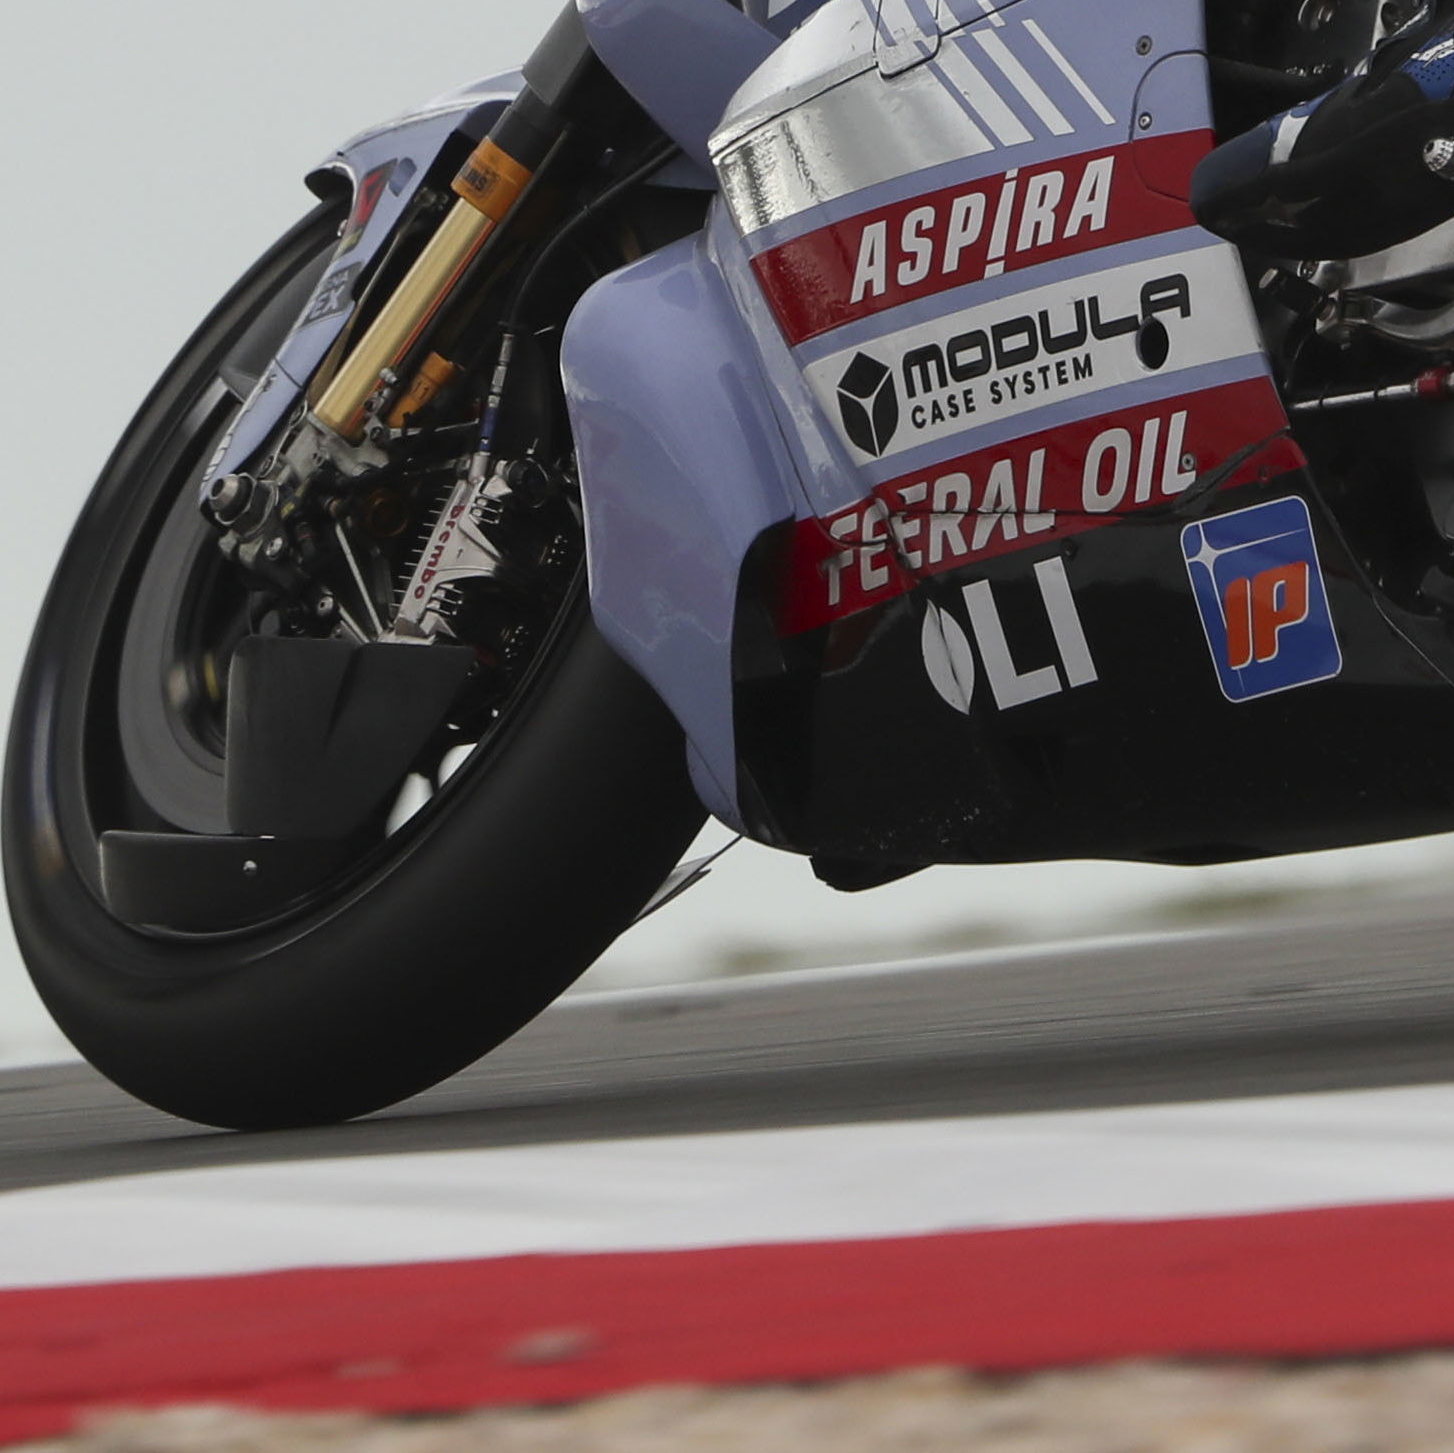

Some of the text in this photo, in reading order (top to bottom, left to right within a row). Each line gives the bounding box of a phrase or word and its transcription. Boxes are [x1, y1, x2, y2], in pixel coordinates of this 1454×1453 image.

[901, 273, 1193, 400] MODULA
[910, 353, 1095, 430] CASE SYSTEM
[1081, 409, 1199, 514] OIL
[414, 504, 467, 600] brembo
[1225, 561, 1309, 669] IP
